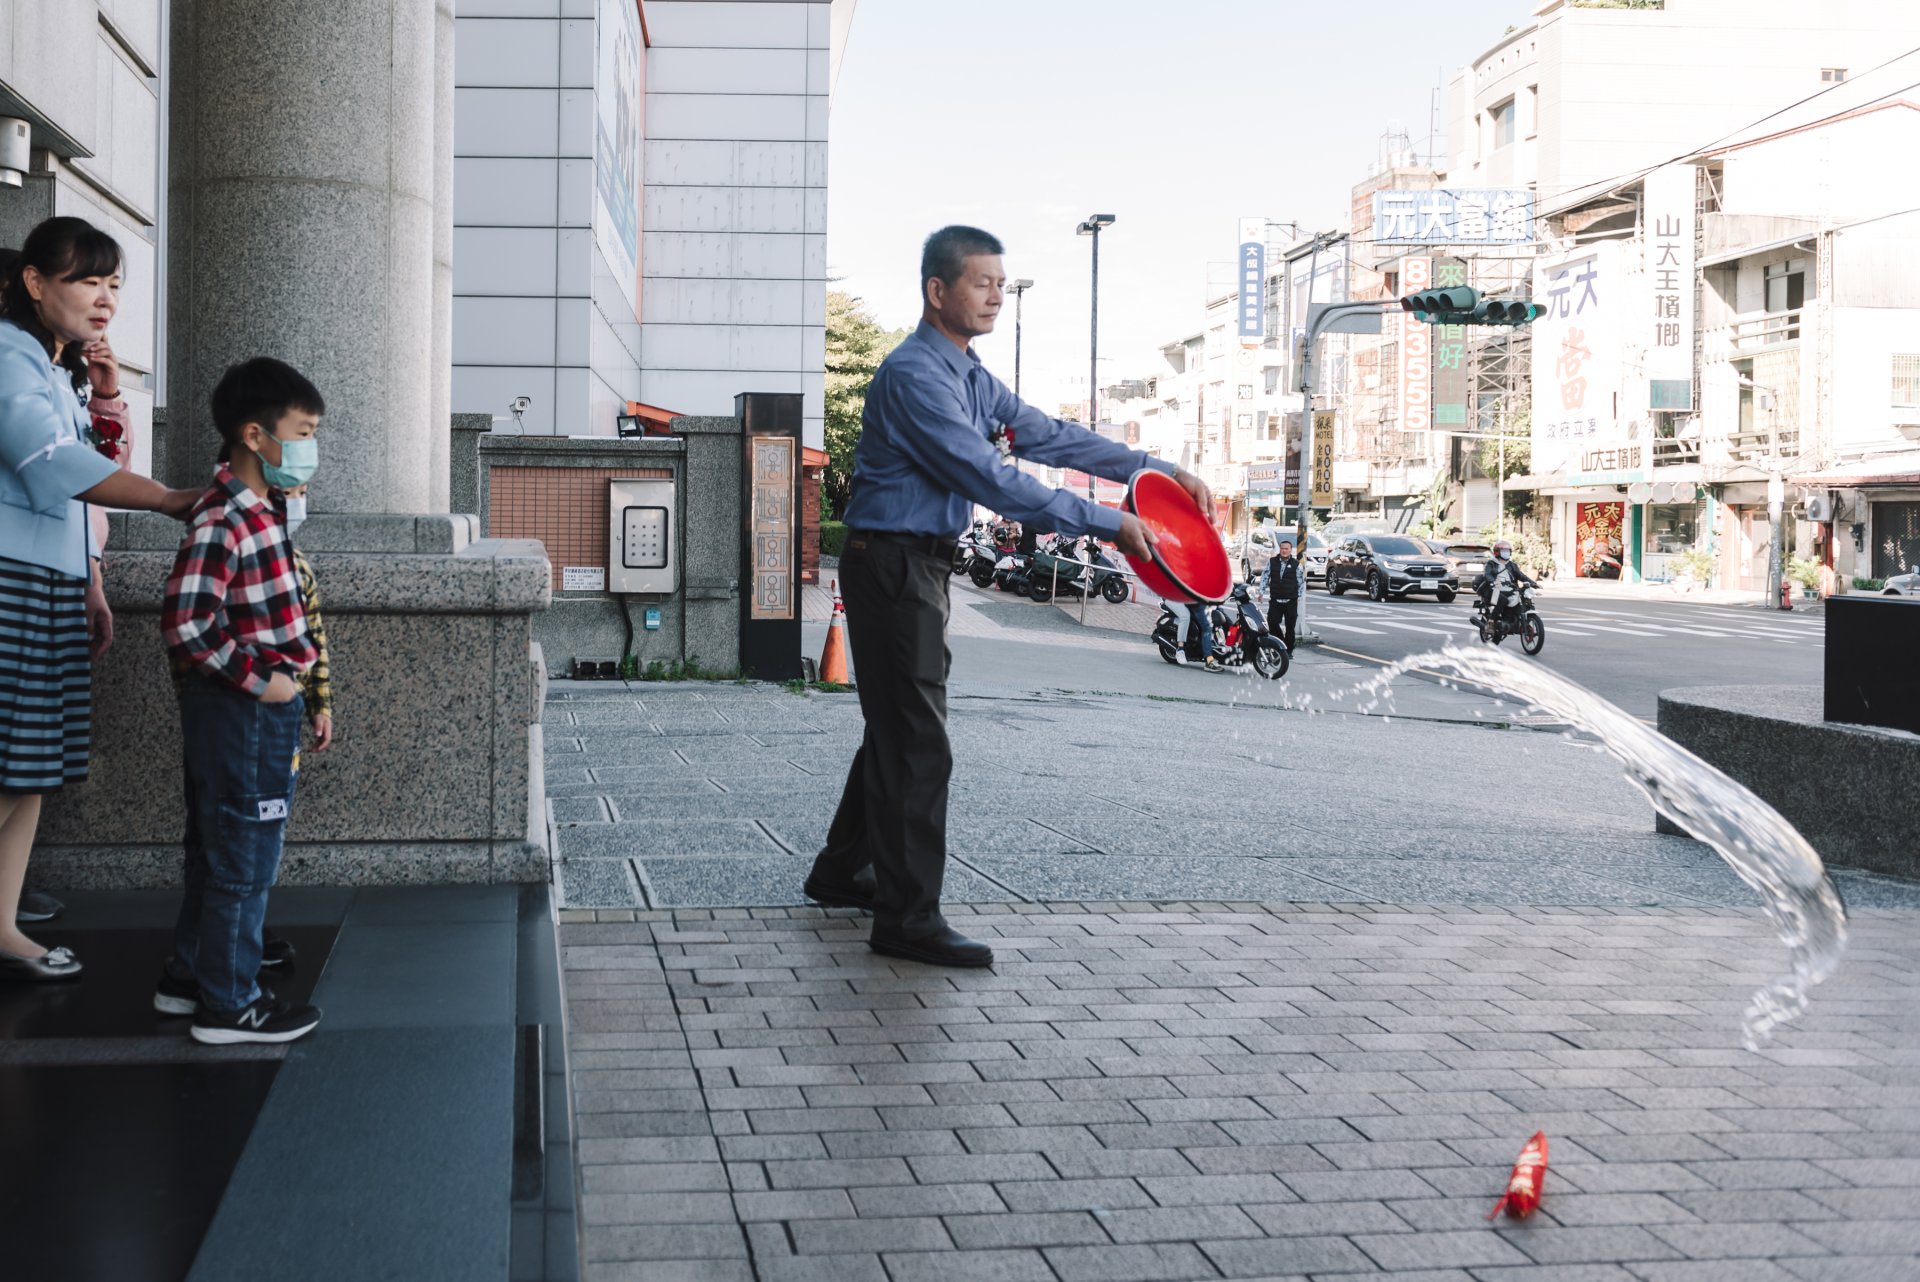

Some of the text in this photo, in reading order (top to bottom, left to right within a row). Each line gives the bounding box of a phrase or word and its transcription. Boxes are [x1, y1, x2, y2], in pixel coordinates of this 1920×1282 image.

[1547, 261, 1597, 321] 元大
[1655, 214, 1680, 347] 山大王檳榔
[1405, 260, 1427, 428] 83555
[1315, 430, 1334, 440] MOTEL
[1581, 446, 1642, 472] 山大王檳榔
[1584, 502, 1621, 521] 元大
